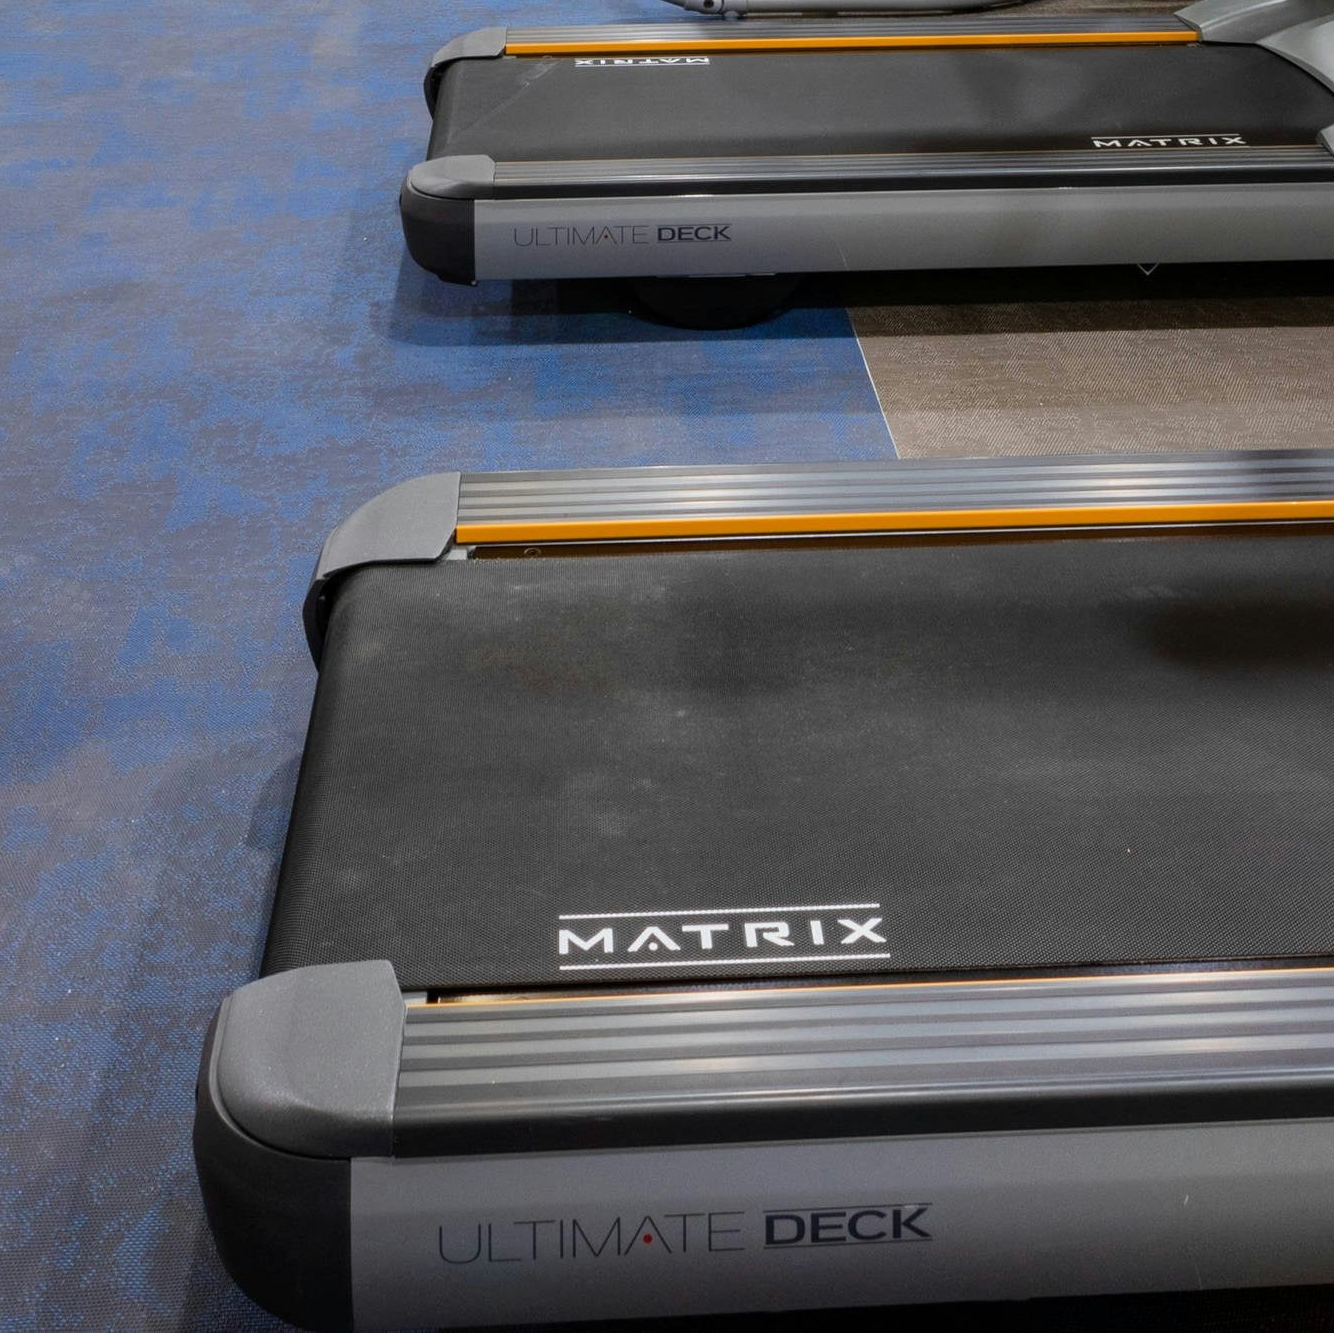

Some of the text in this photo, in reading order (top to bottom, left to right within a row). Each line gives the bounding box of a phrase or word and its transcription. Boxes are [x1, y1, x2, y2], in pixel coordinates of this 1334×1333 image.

[575, 56, 710, 66] MATRIX
[1093, 136, 1247, 148] MATRIX
[513, 225, 731, 247] ULTIMATE DECK
[558, 918, 888, 955] MATRIX
[438, 1207, 932, 1265] ULTIMATE DECK
